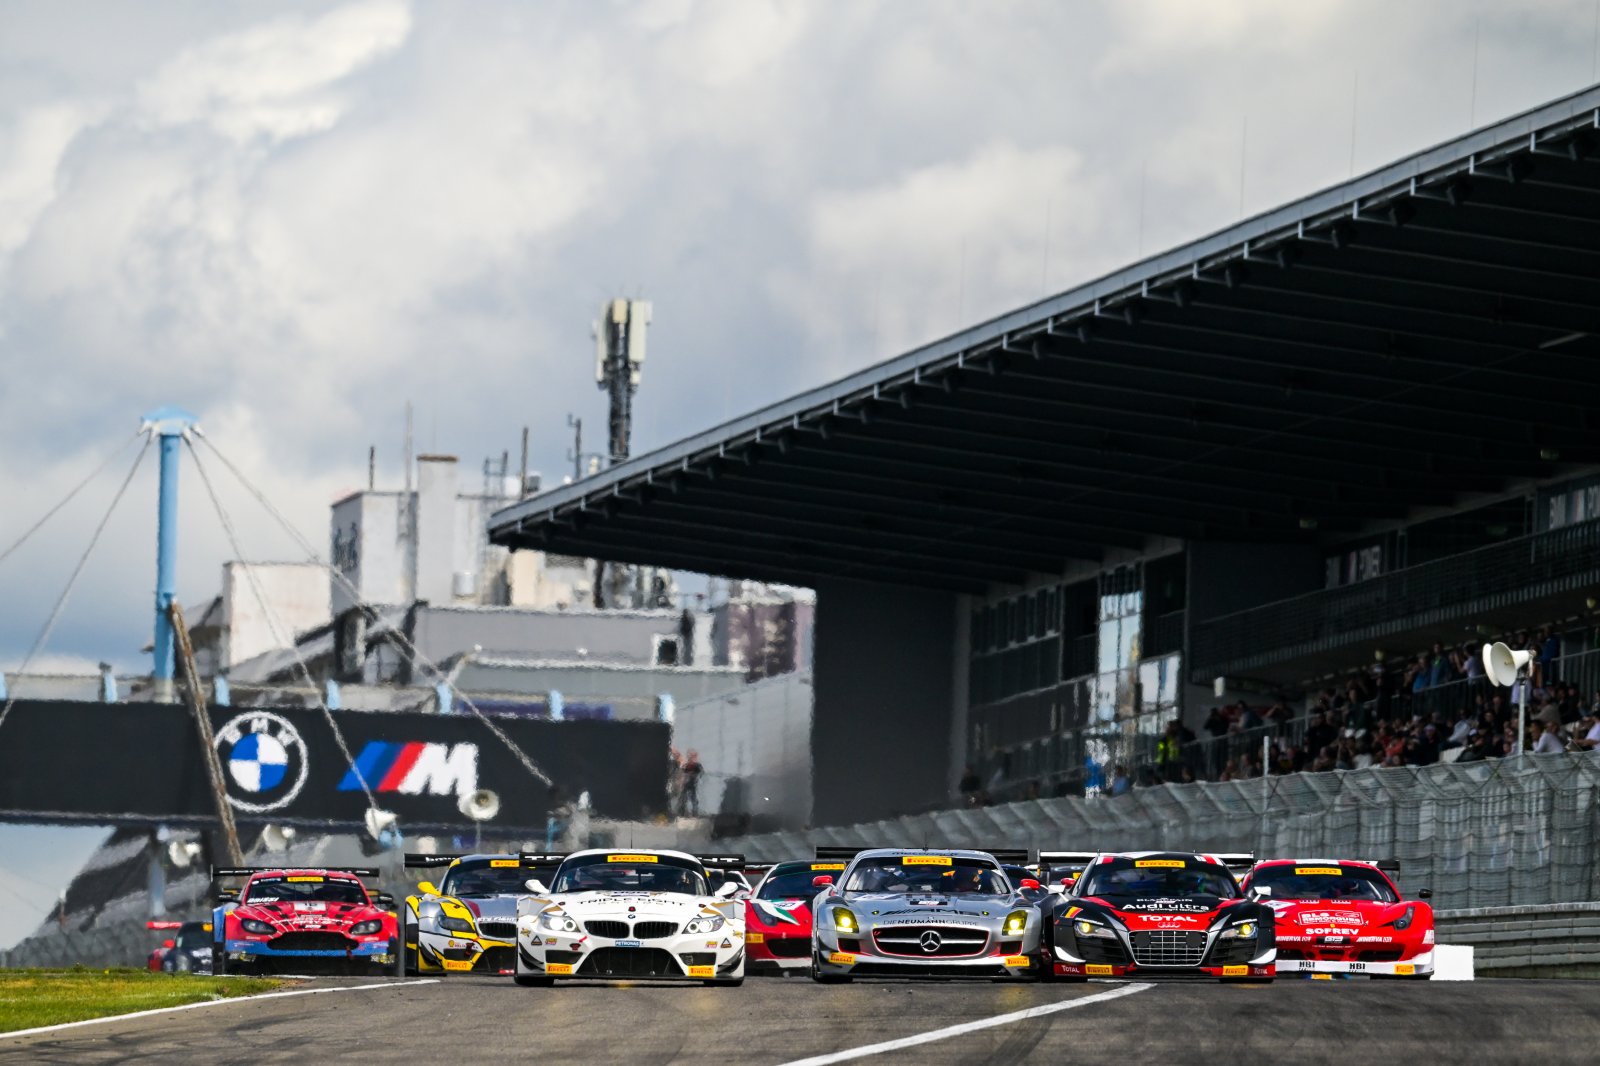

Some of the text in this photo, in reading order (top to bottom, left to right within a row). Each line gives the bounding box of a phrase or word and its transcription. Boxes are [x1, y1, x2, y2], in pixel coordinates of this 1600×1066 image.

[1168, 903, 1210, 911] ultra
[1138, 914, 1198, 923] TOTAL
[1305, 927, 1360, 935] SOFREV
[829, 953, 853, 963] PIRELLI
[1007, 957, 1028, 965] PIRELLI
[1061, 965, 1080, 973] TOTAL
[1086, 966, 1110, 974] PIRELLI
